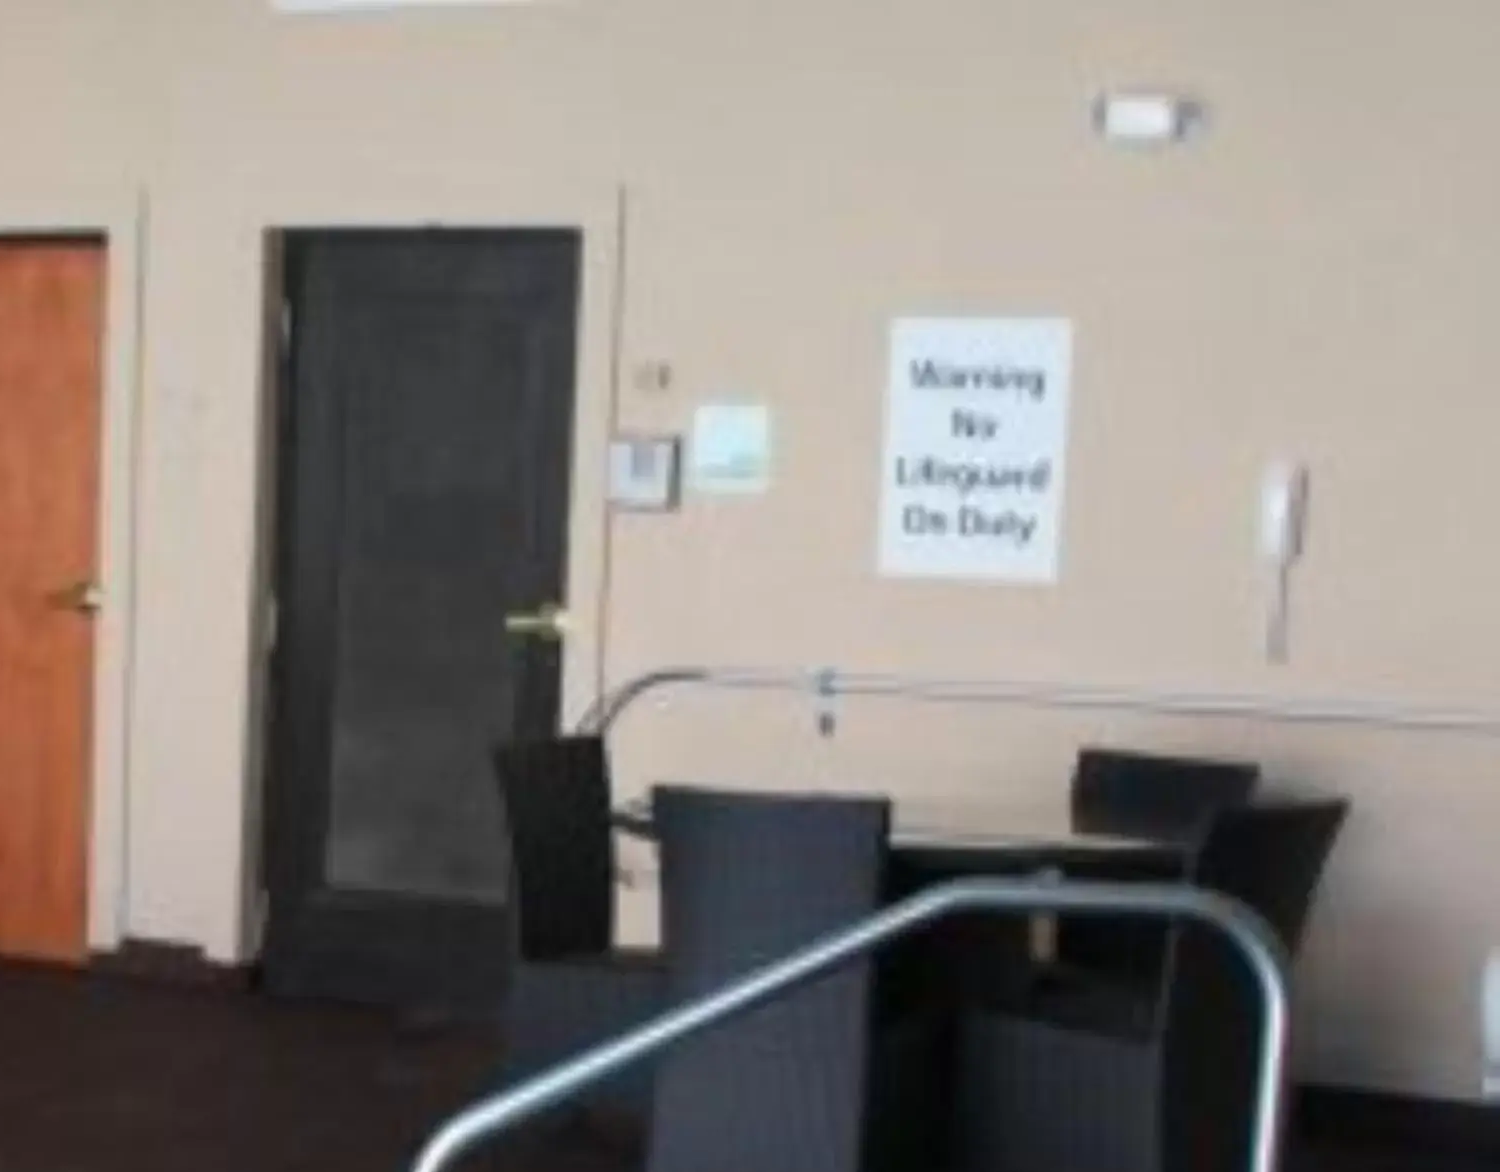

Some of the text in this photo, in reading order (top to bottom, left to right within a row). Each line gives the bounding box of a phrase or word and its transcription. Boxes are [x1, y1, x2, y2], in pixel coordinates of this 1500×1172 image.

[909, 358, 1046, 403] Warning
[902, 503, 1037, 546] On Duty
